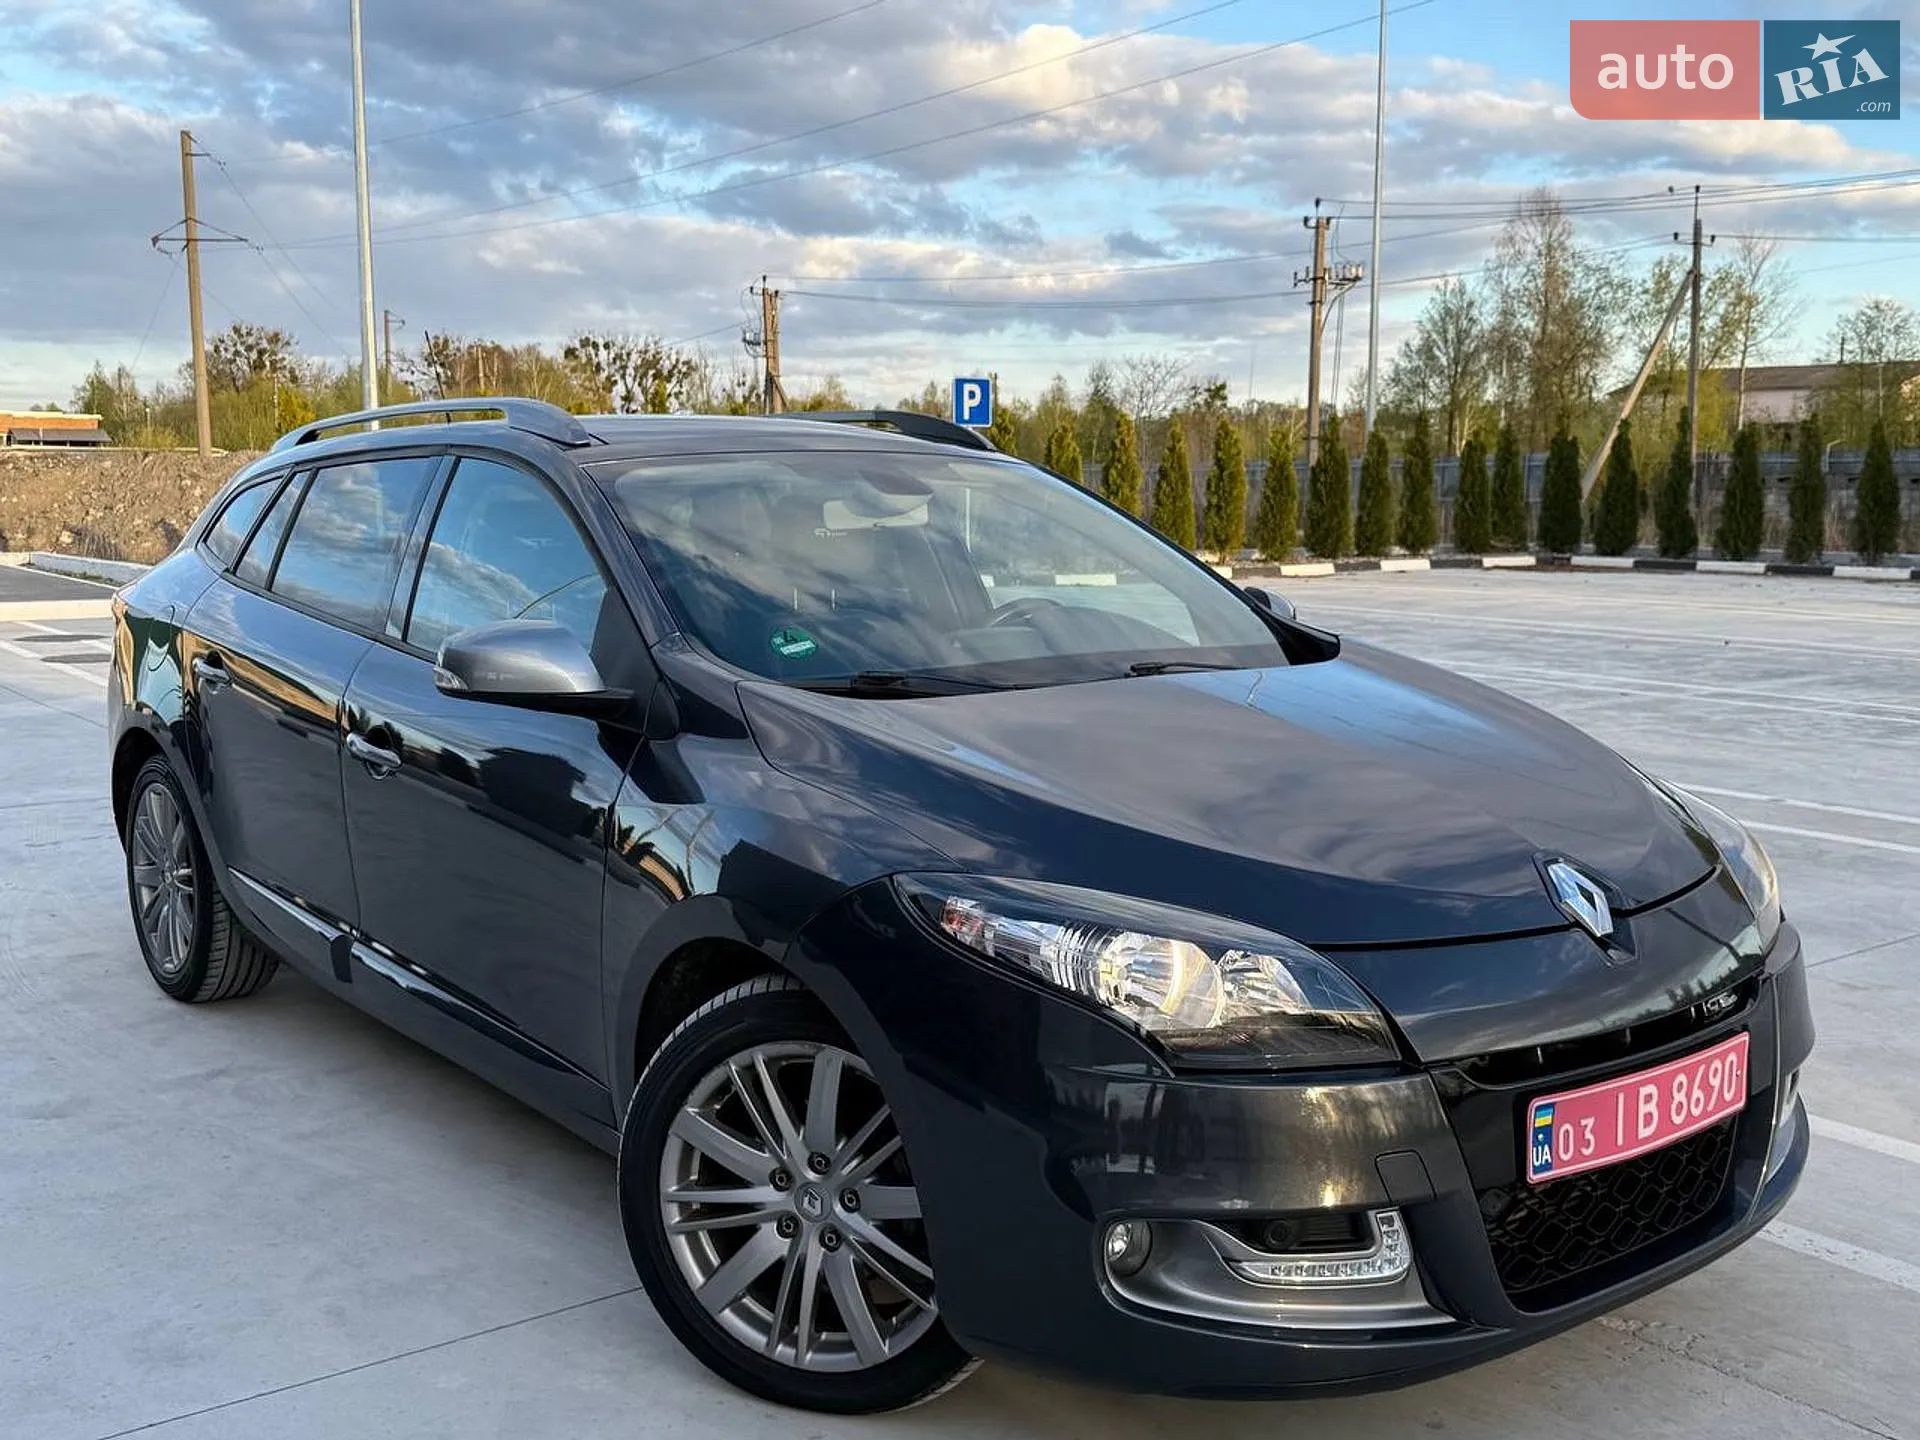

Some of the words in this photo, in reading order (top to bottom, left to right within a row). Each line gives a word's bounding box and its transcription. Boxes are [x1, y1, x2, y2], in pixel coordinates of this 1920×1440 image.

[963, 383, 981, 420] P
[1558, 1117, 1596, 1161] 03
[1671, 1052, 1738, 1125] 8690
[1533, 1144, 1551, 1166] UA
